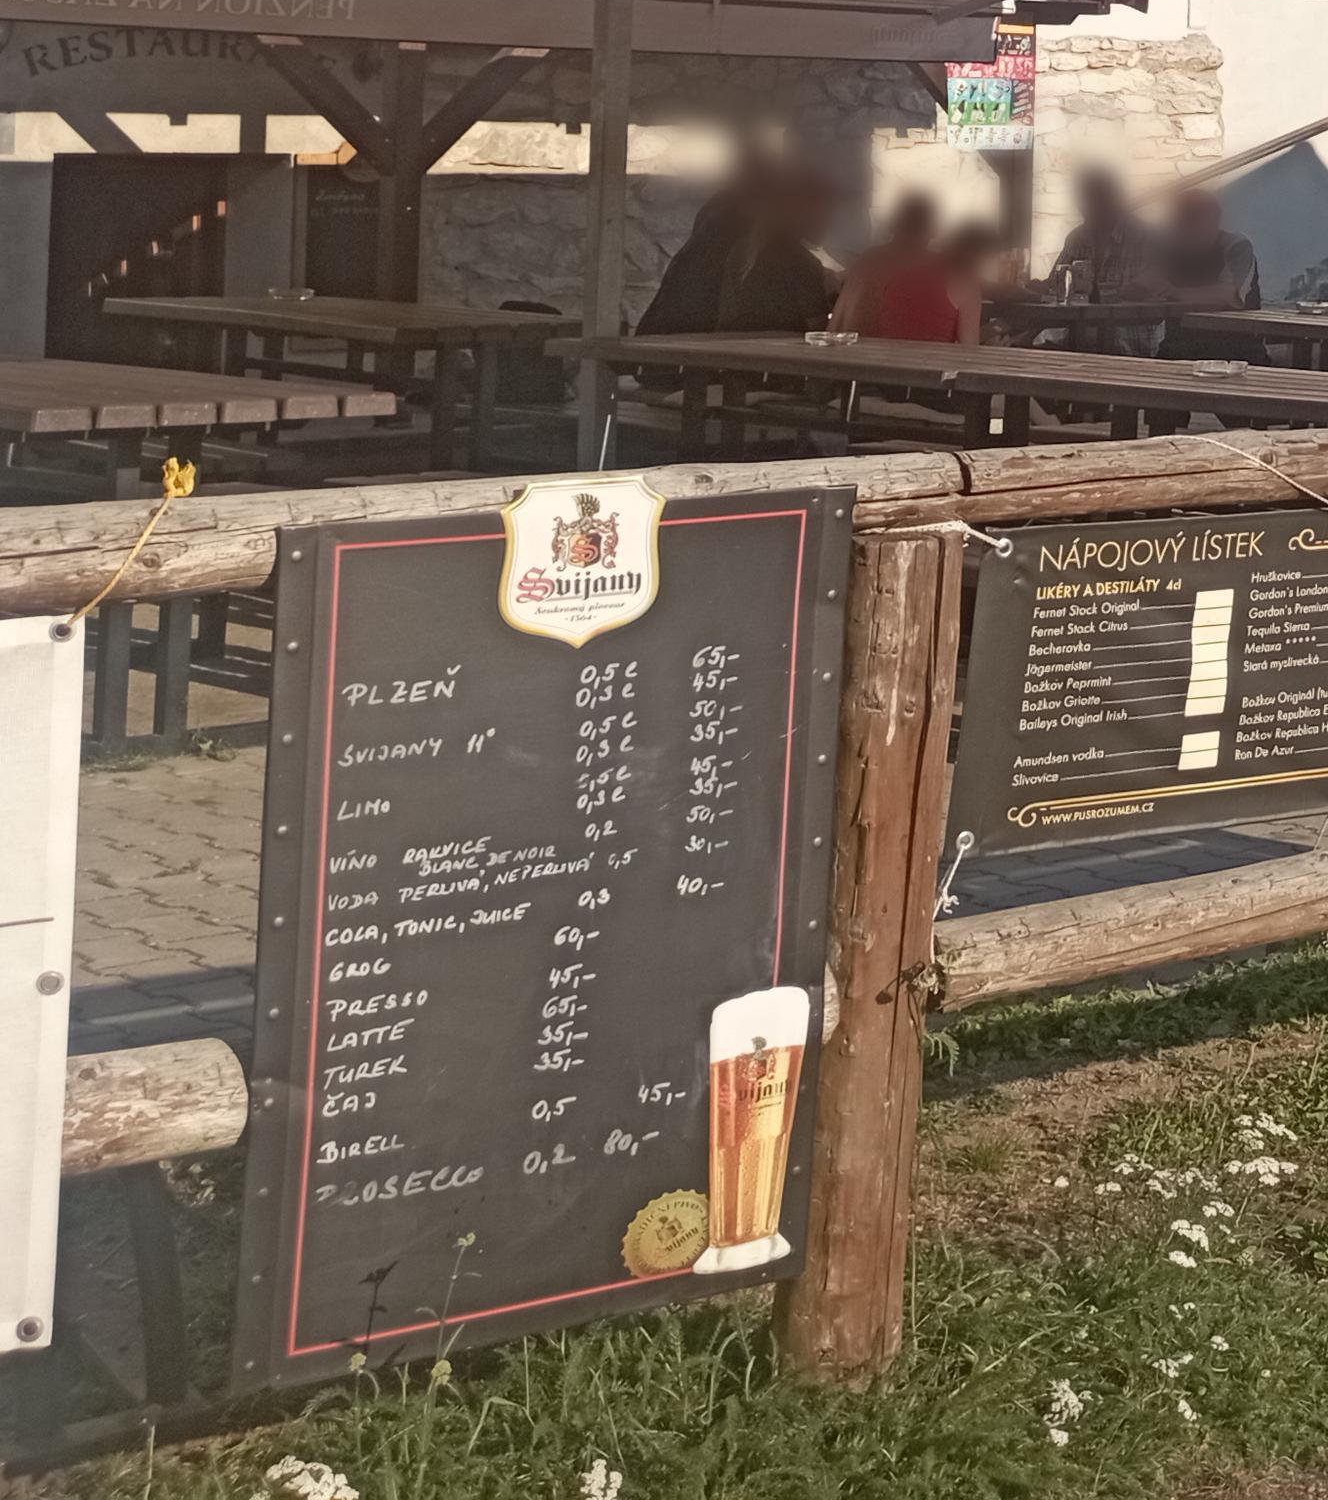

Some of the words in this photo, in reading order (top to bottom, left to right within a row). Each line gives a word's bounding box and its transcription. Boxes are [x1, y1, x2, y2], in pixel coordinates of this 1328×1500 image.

[1039, 531, 1187, 572] NÁPOJOVÝ
[1192, 529, 1265, 562] LÍSTEK
[516, 567, 642, 603] Svijany
[1036, 581, 1080, 601] LIKÉRY
[1083, 581, 1095, 597] A
[1096, 576, 1161, 596] DESTILÁTY
[1250, 571, 1302, 584] Hruškovice
[1296, 584, 1328, 597] London
[1033, 606, 1067, 620] Fernet
[1068, 602, 1098, 617] Stock
[1101, 599, 1141, 617] Original
[1031, 625, 1064, 638] Fernet
[1066, 621, 1096, 636] Stock
[1098, 620, 1128, 633] Citrus
[1246, 623, 1281, 638] Tequila
[1028, 640, 1092, 657] Becherovka
[1024, 660, 1093, 677] Jägermeister
[342, 664, 462, 707] PLZEŇ
[580, 662, 621, 690] 0,5
[576, 684, 613, 709] 0,3
[1024, 680, 1064, 694] Božkov
[1066, 676, 1112, 692] Peprmint
[1021, 698, 1061, 713] Božkov
[1063, 695, 1101, 708] Griotte
[579, 715, 618, 740] 0,5
[1019, 717, 1058, 731] Baileys
[1060, 712, 1103, 728] Original
[1105, 708, 1128, 722] Irish
[576, 739, 611, 767] 0,3
[1013, 752, 1070, 769] Amundsen
[1072, 747, 1105, 761] vodka
[1012, 773, 1060, 787] Slivovice
[576, 789, 606, 814] 0,3
[329, 849, 378, 874] VÍNO
[585, 820, 619, 841] 0,2
[327, 891, 379, 911] VODA
[469, 902, 532, 925] JUICE
[577, 887, 611, 910] 0,3
[329, 958, 392, 983] GROG
[326, 989, 428, 1022] PRESSO
[327, 1018, 415, 1052] LATTE
[323, 1054, 407, 1090] TUREK
[322, 1092, 377, 1117] ČAJ
[316, 1134, 405, 1164] BIRELL
[531, 1096, 577, 1122] 0,5
[523, 1143, 576, 1175] 0,2
